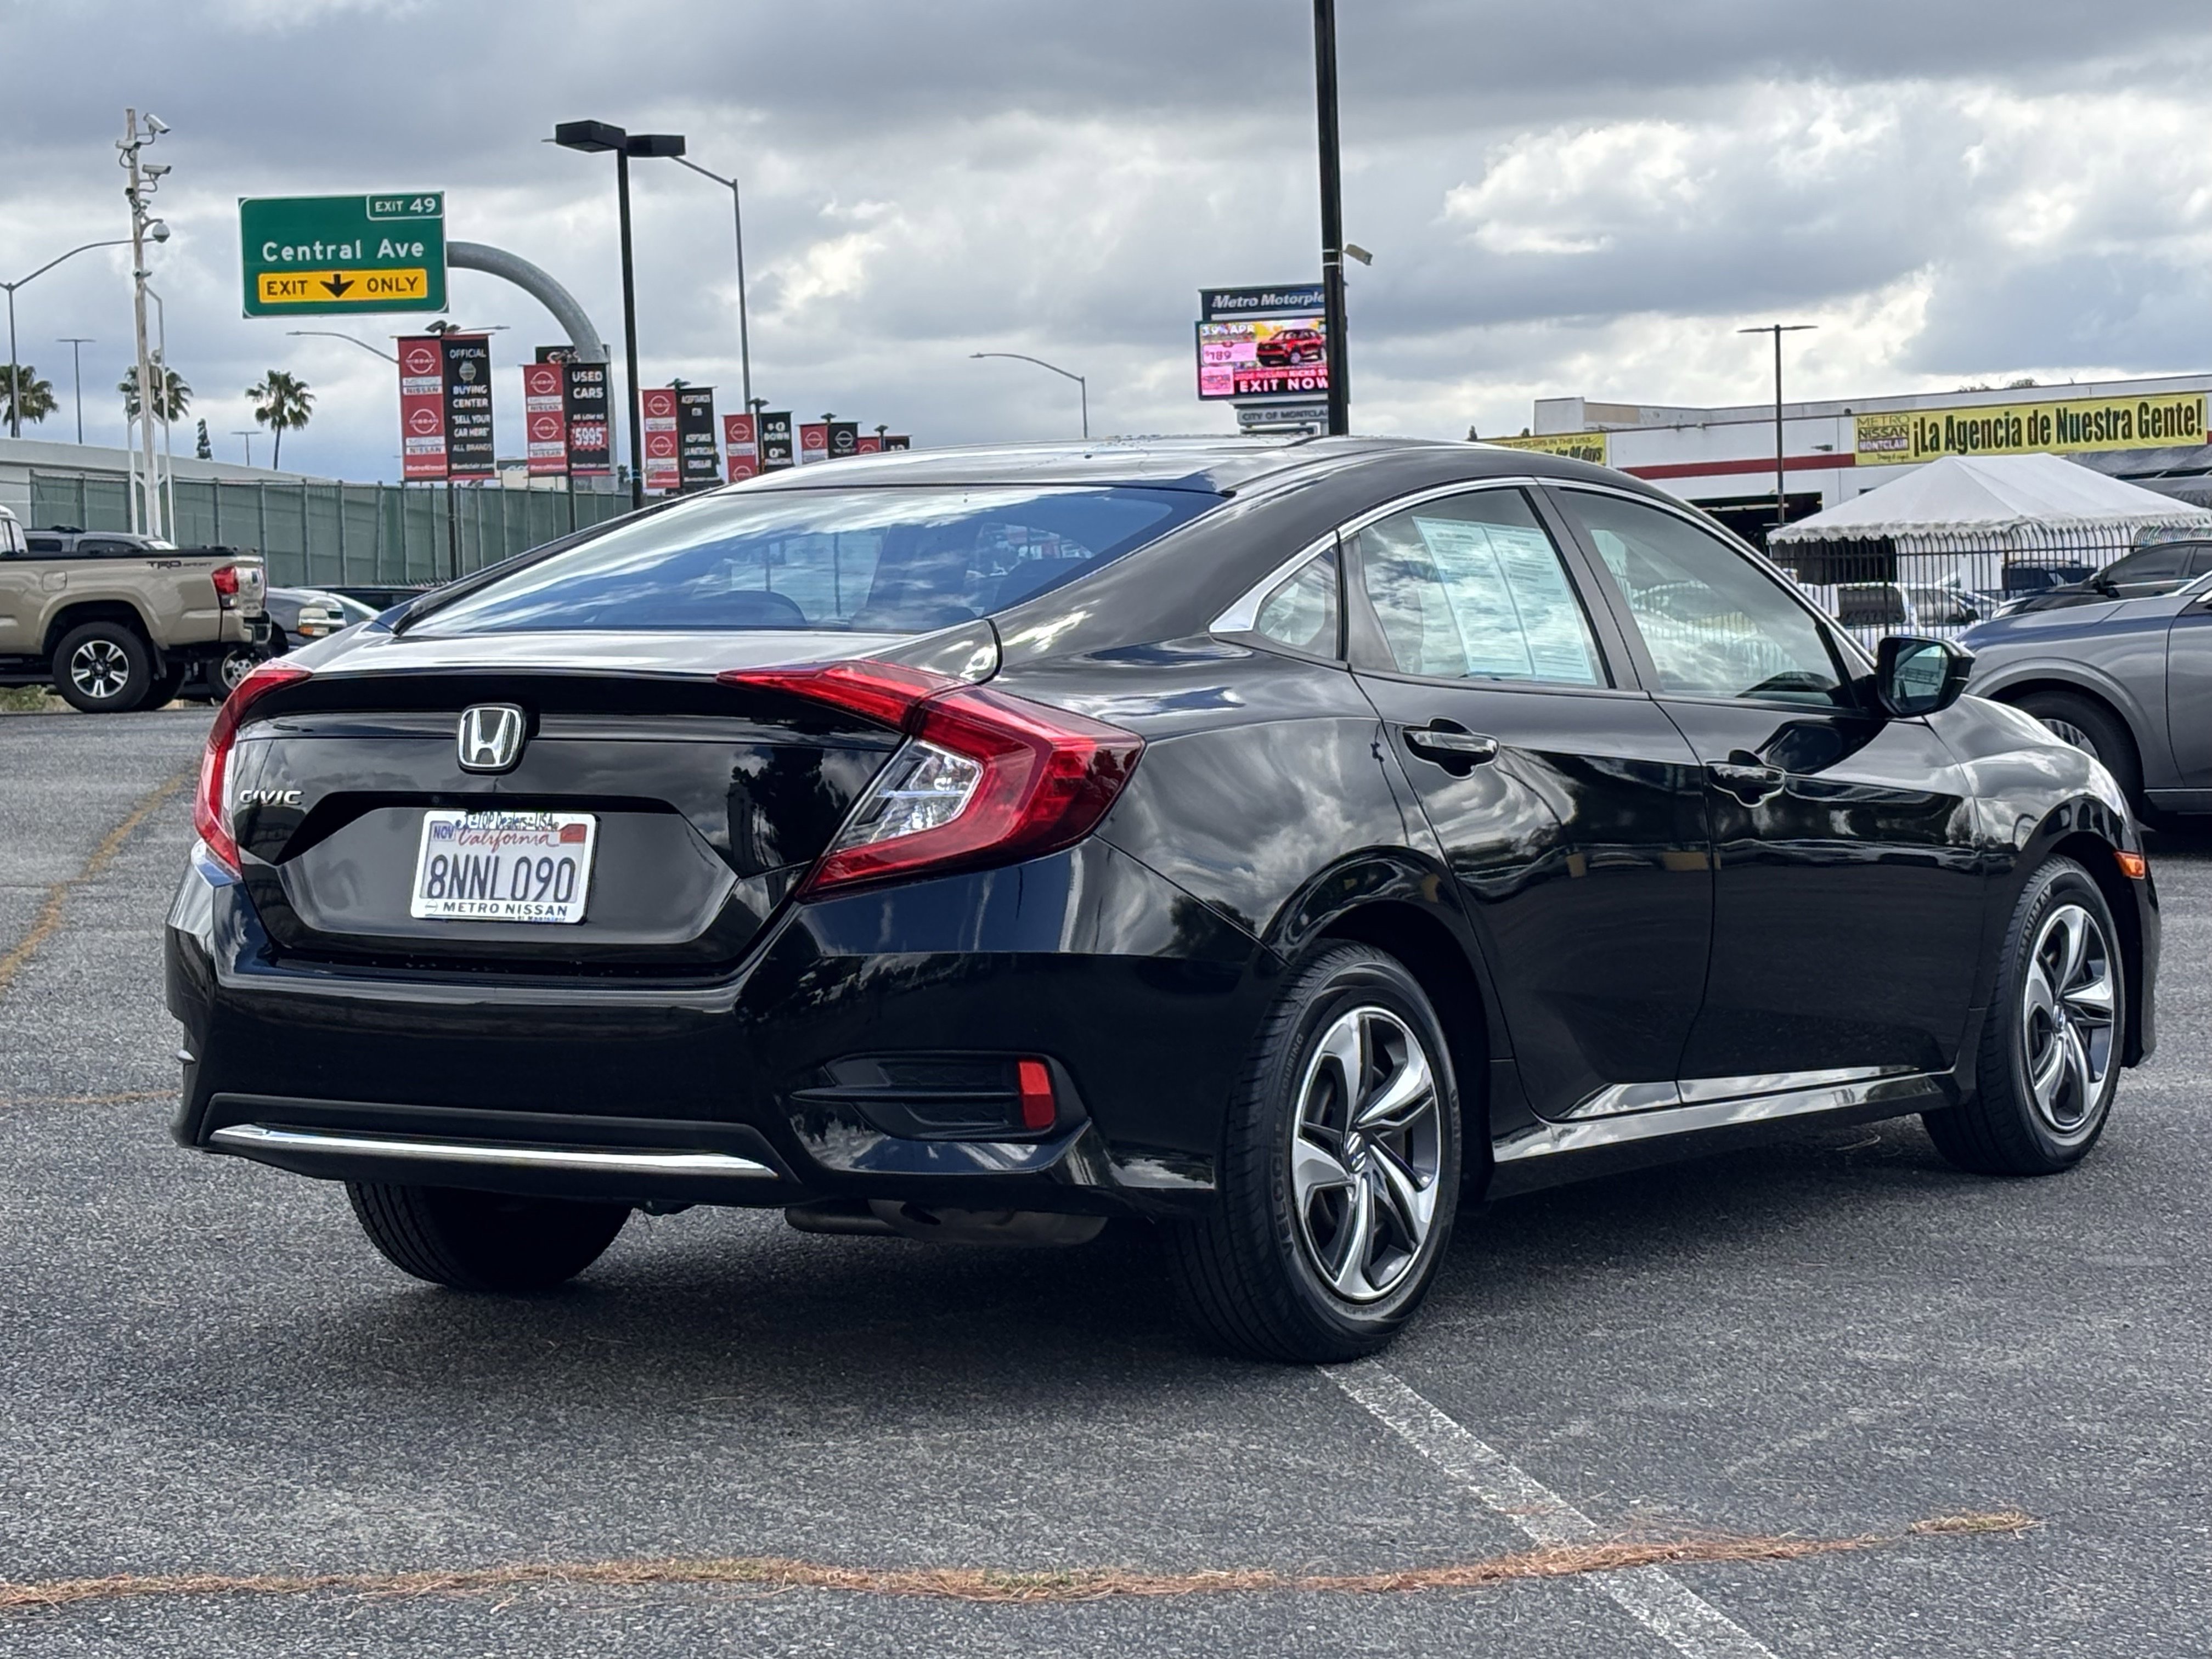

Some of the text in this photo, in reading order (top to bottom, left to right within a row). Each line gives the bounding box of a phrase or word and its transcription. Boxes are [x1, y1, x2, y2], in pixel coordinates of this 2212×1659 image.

[375, 198, 436, 213] EXIT 49
[262, 239, 425, 262] Central Ave
[267, 276, 419, 296] EXIT ONLY
[1212, 295, 1259, 308] Metro
[1231, 324, 1256, 334] APR
[449, 348, 487, 358] OFFICIAL
[572, 371, 603, 382] USED
[453, 385, 487, 394] BUYING
[1240, 379, 1279, 393] EXIT
[573, 387, 603, 399] CARS
[453, 398, 489, 408] CENTER
[472, 414, 490, 424] YOUR
[1857, 415, 1910, 427] METRO
[454, 427, 469, 438] CAR
[1858, 426, 1909, 439] NISSAN
[1914, 398, 2202, 457] ¡La Agencia de Nuestra Gente!
[764, 432, 789, 441] DOWN
[453, 443, 493, 452] ALL BRANDS
[1859, 438, 1909, 452] MONTCLAIR
[146, 560, 182, 569] TRD
[239, 789, 304, 805] CIVIC
[433, 825, 454, 839] NOV
[458, 827, 560, 853] California
[427, 853, 576, 903] 8NNL090
[443, 901, 568, 917] METRO NISSAN
